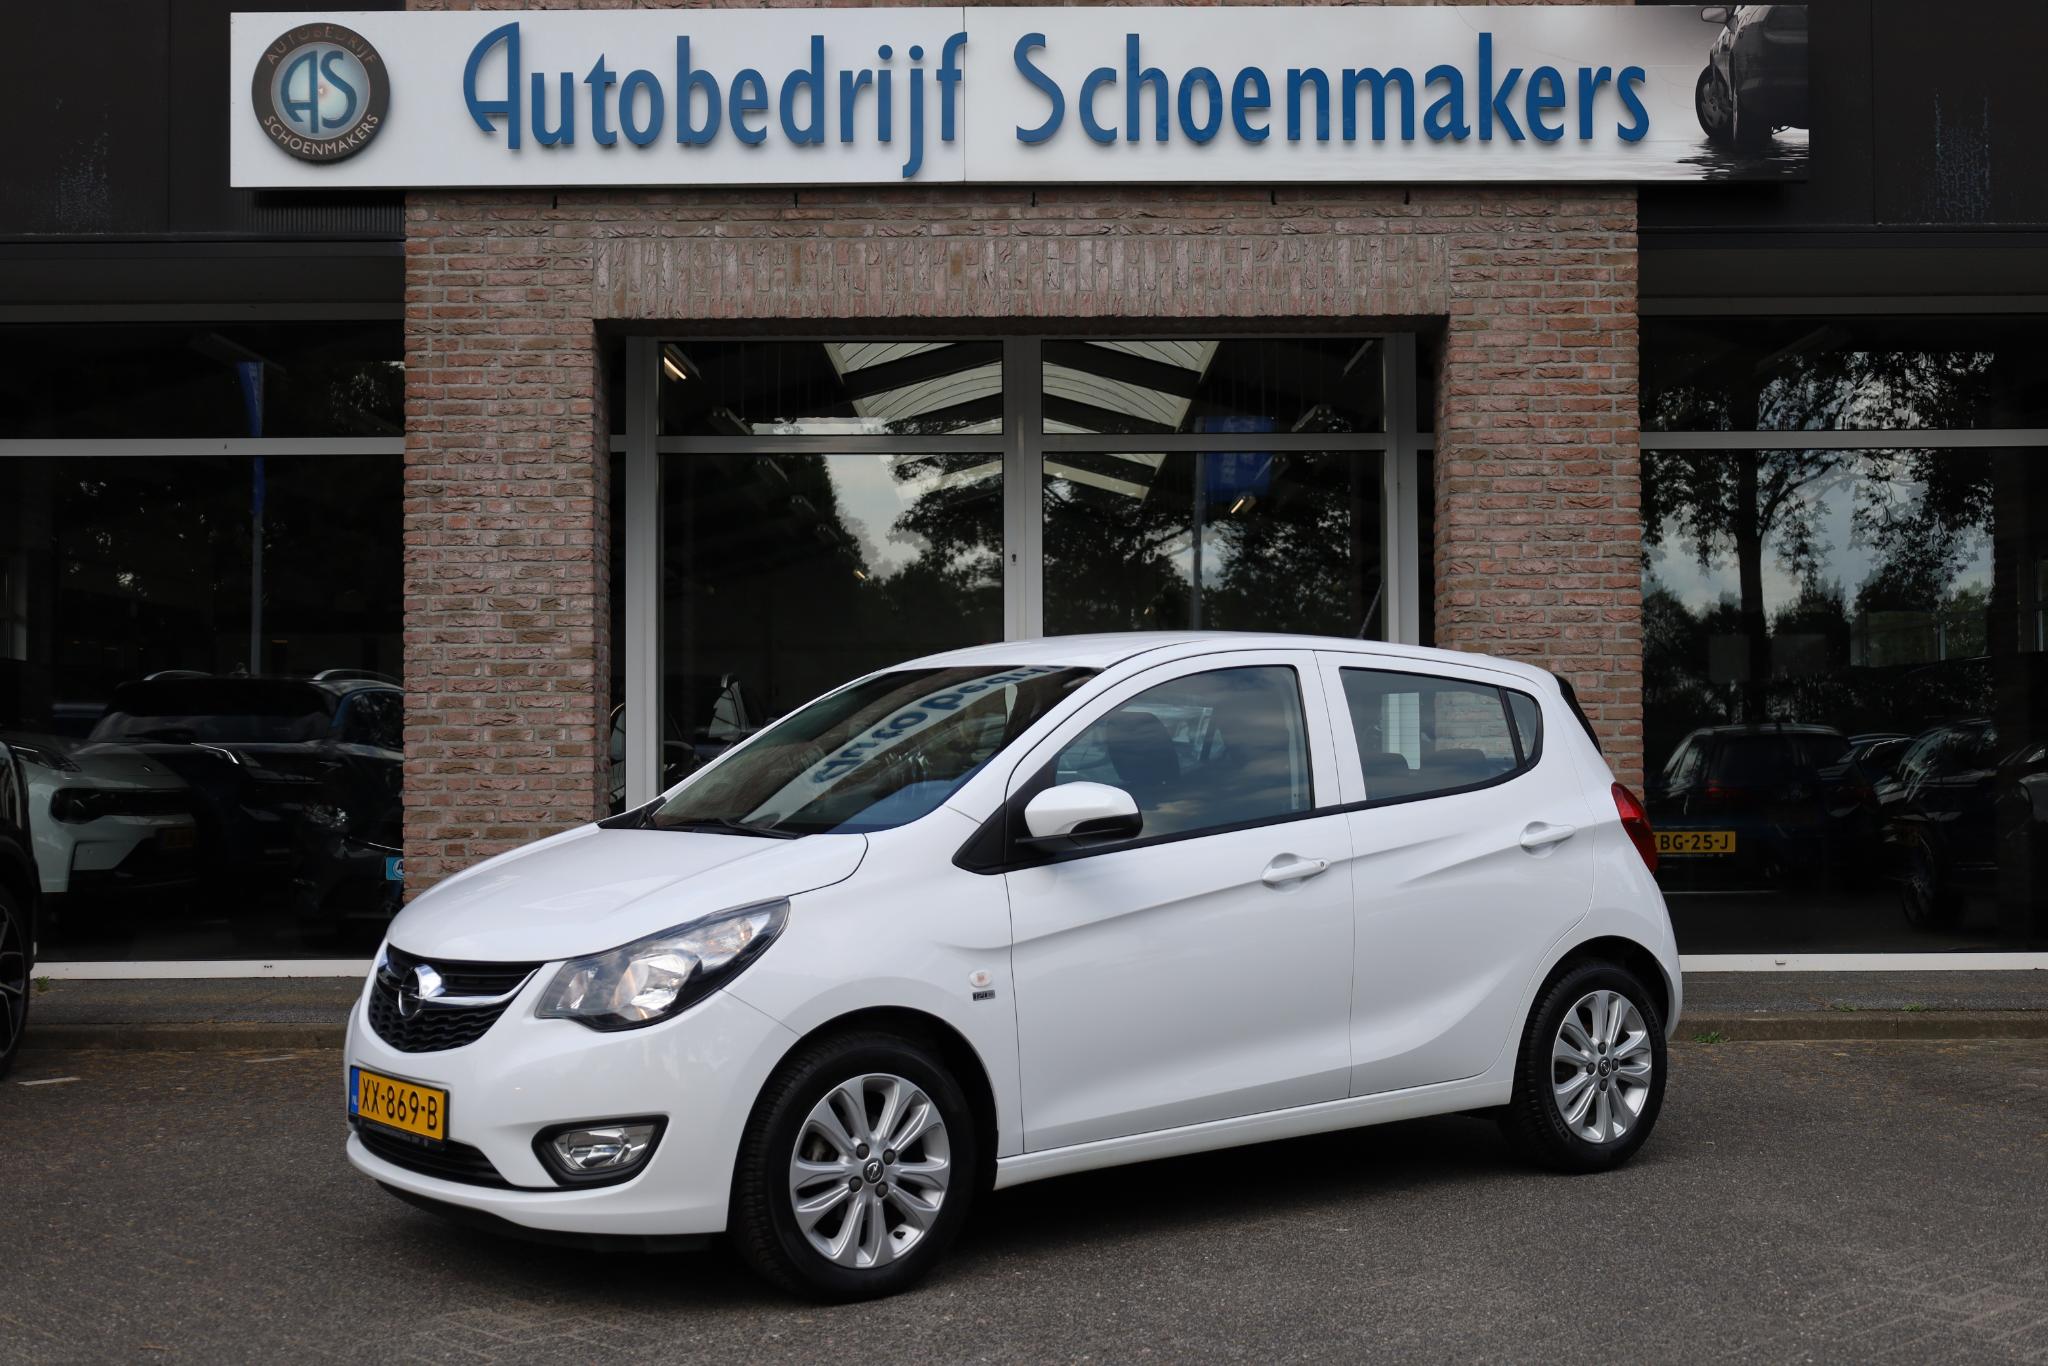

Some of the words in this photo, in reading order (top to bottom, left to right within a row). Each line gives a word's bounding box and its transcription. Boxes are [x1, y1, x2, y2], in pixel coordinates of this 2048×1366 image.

[281, 50, 357, 134] AS
[463, 22, 968, 178] Autobedrijf
[1013, 33, 1650, 143] Schoenmakers
[264, 114, 379, 155] SCHOENMAKERS
[1652, 834, 1728, 850] BG-25-J
[362, 1077, 438, 1131] XX-869-B
